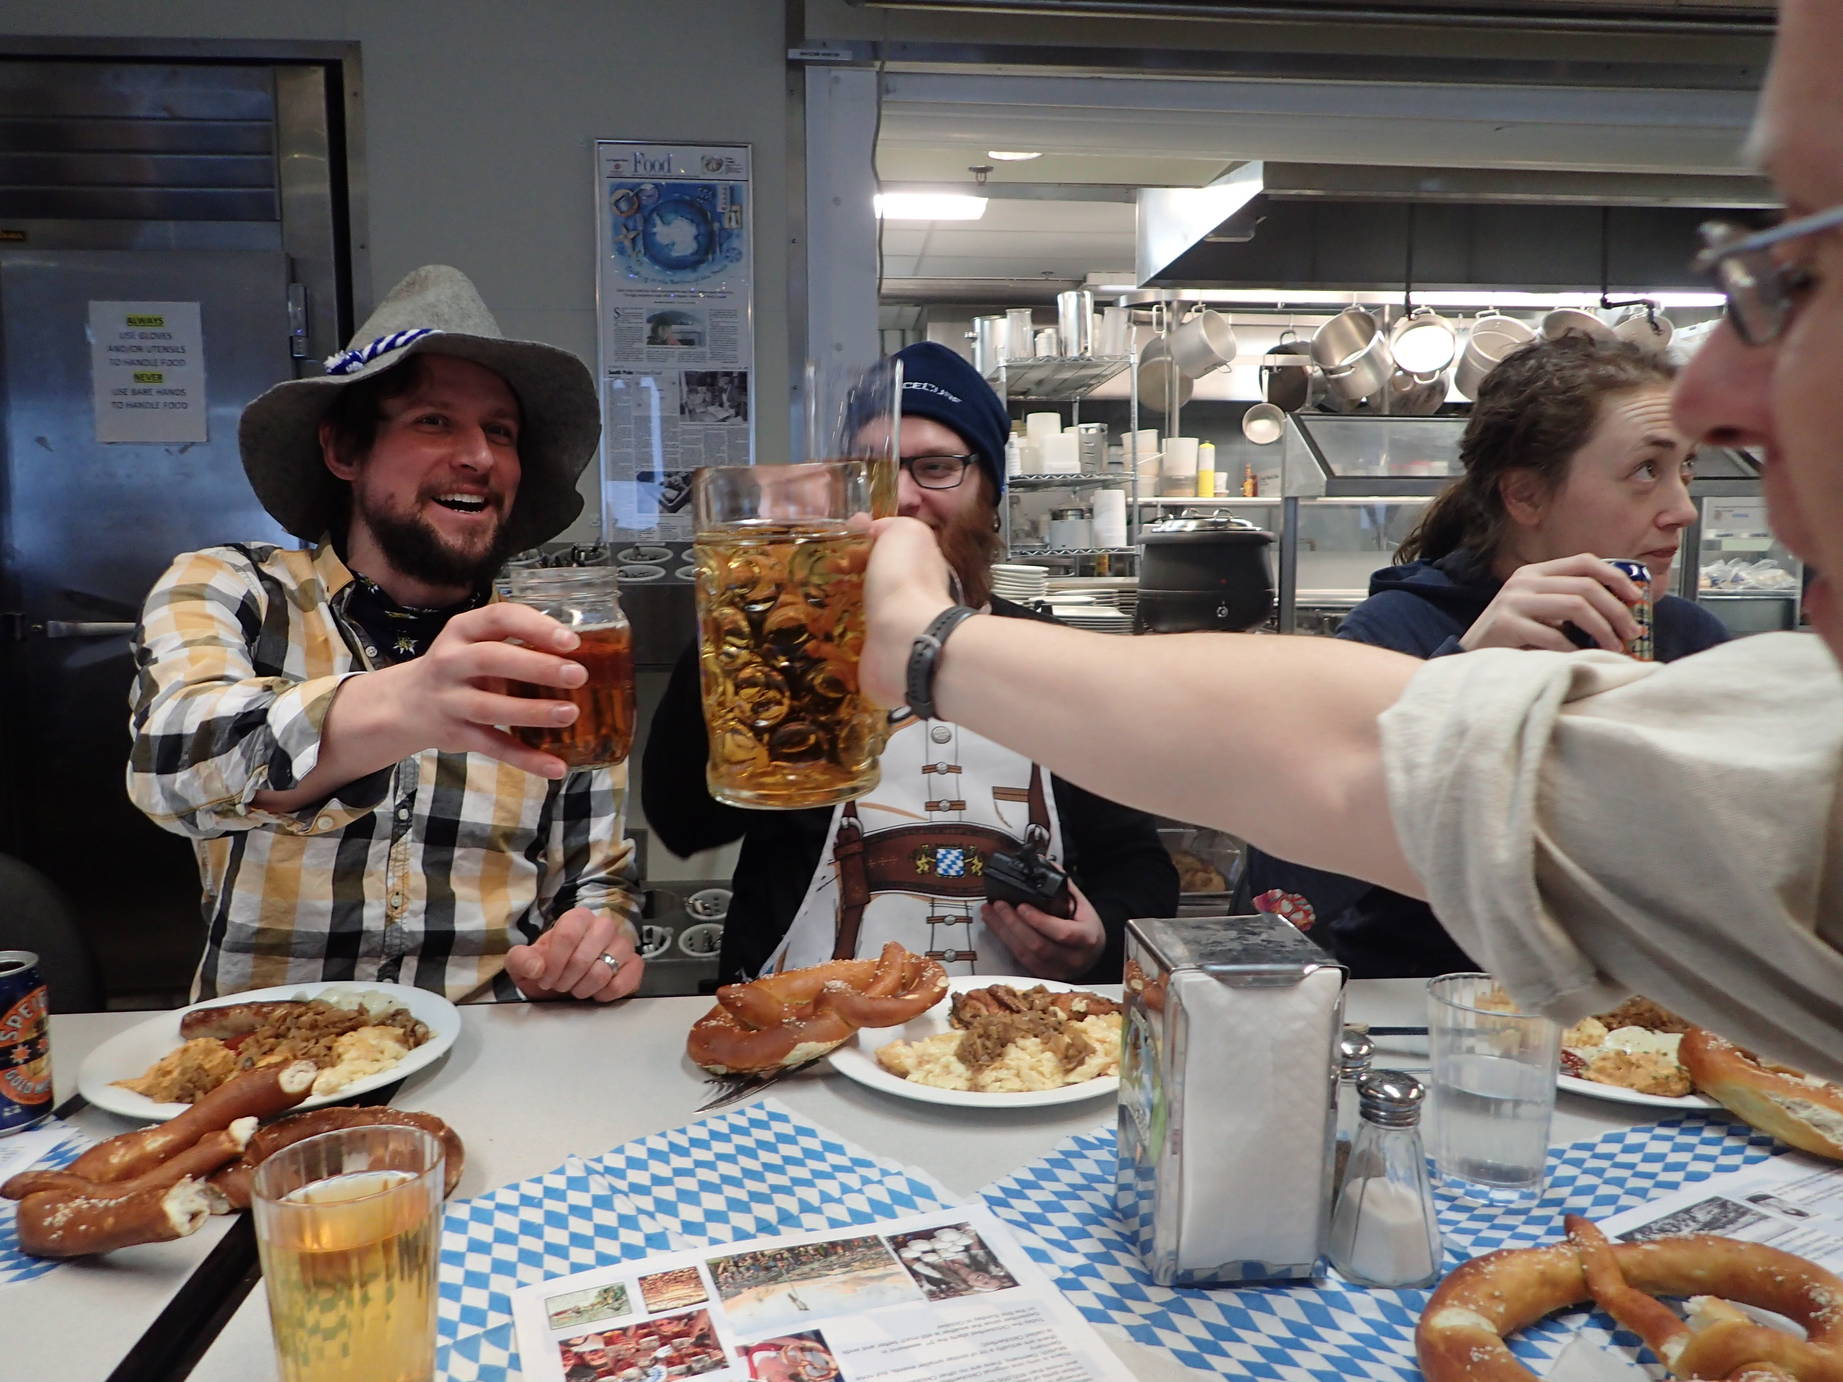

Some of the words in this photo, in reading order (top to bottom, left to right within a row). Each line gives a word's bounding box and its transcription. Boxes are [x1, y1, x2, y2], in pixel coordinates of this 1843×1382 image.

[633, 152, 672, 174] Food
[127, 317, 164, 327] ALWAYS
[119, 332, 136, 340] USE
[138, 332, 172, 340] GLOVES
[147, 345, 186, 354] UTENSILS
[109, 359, 121, 367] TO
[124, 359, 159, 367] HANDLE
[161, 359, 186, 367] FOOD
[134, 373, 163, 383] NEVER
[112, 388, 129, 396] USE
[131, 388, 153, 396] BARE
[156, 388, 187, 397] HANDS
[111, 402, 124, 410] TO
[126, 402, 160, 410] HANDLE
[163, 402, 188, 410] FOOD
[5, 1069, 33, 1094] GOLD
